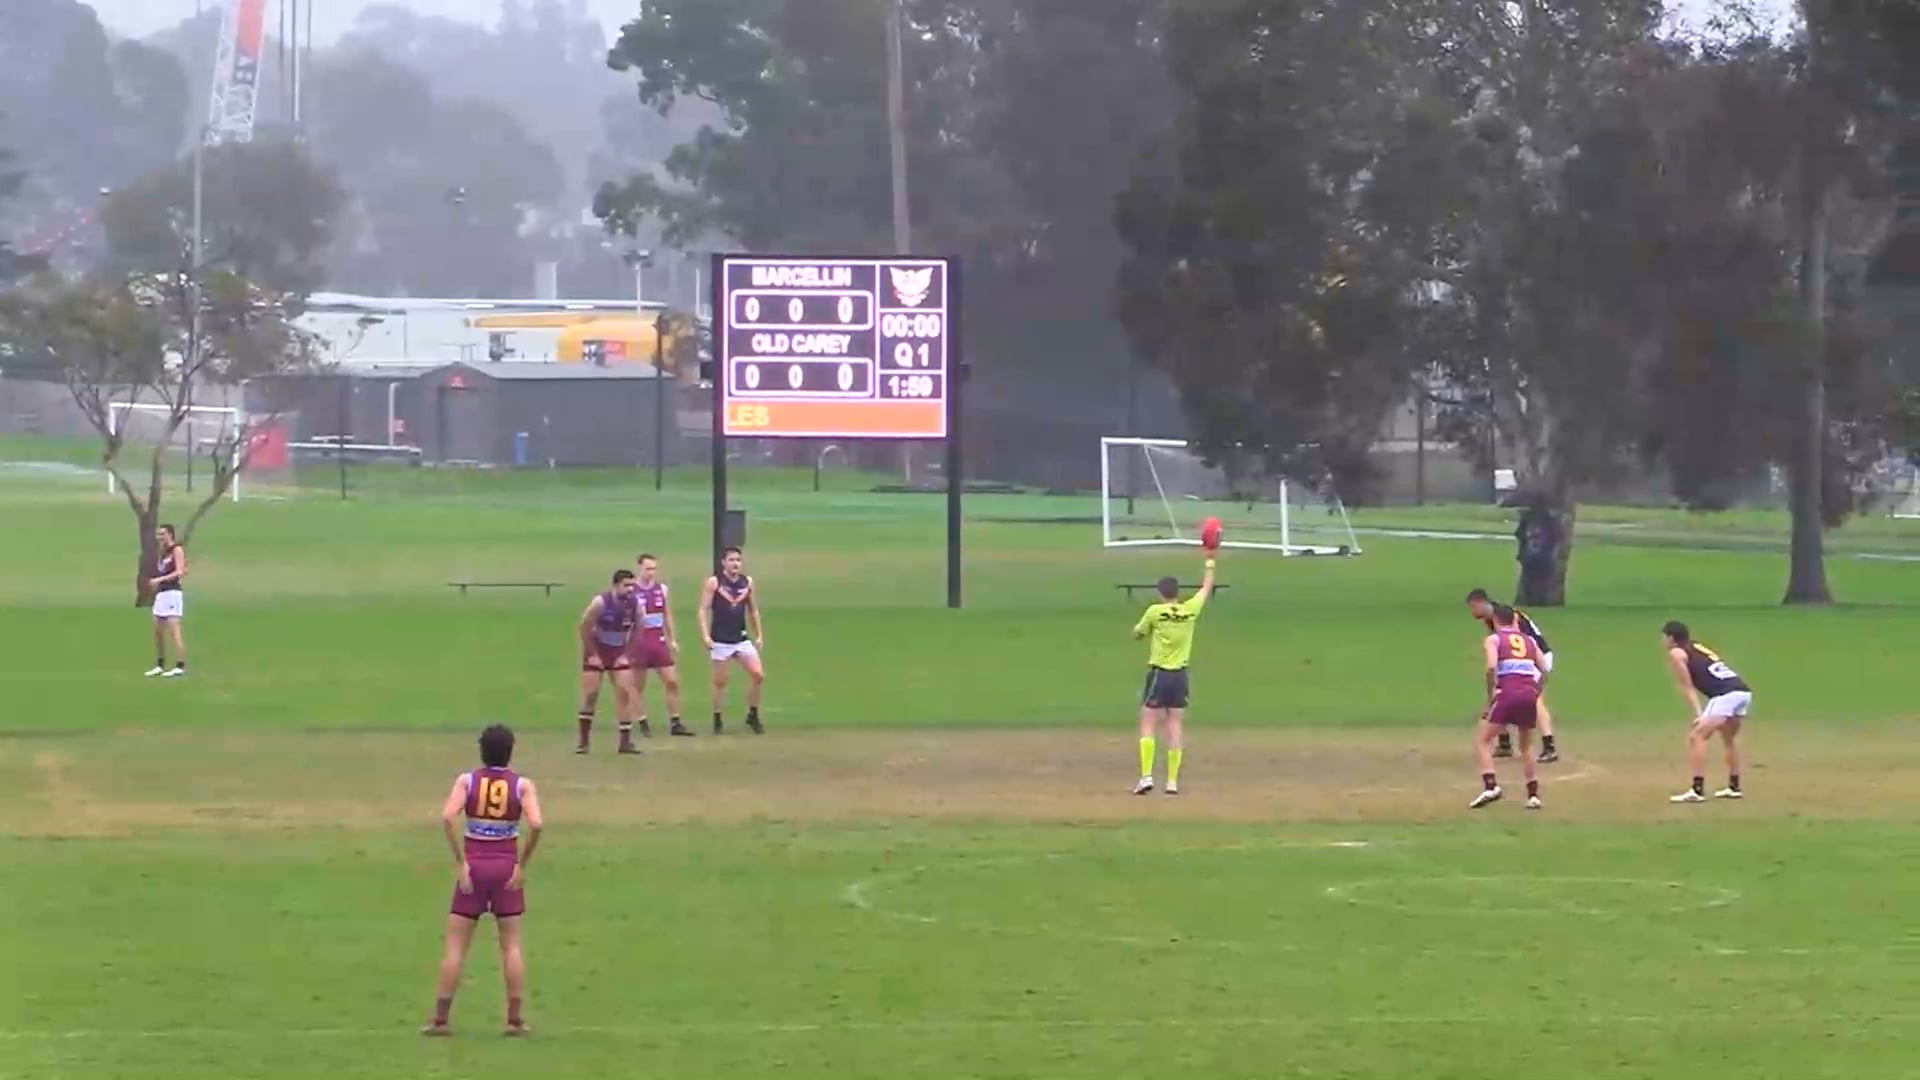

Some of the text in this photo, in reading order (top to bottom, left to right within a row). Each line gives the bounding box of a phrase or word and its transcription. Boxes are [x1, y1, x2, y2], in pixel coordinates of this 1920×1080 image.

[752, 267, 852, 287] MARCELLIN
[745, 297, 853, 323] 0 0 0
[882, 314, 941, 338] 00:00
[752, 334, 851, 354] OLD CAREY
[894, 343, 929, 367] Q 1
[745, 363, 853, 390] 0 0 0
[1508, 634, 1527, 658] 9
[476, 777, 508, 817] 19
